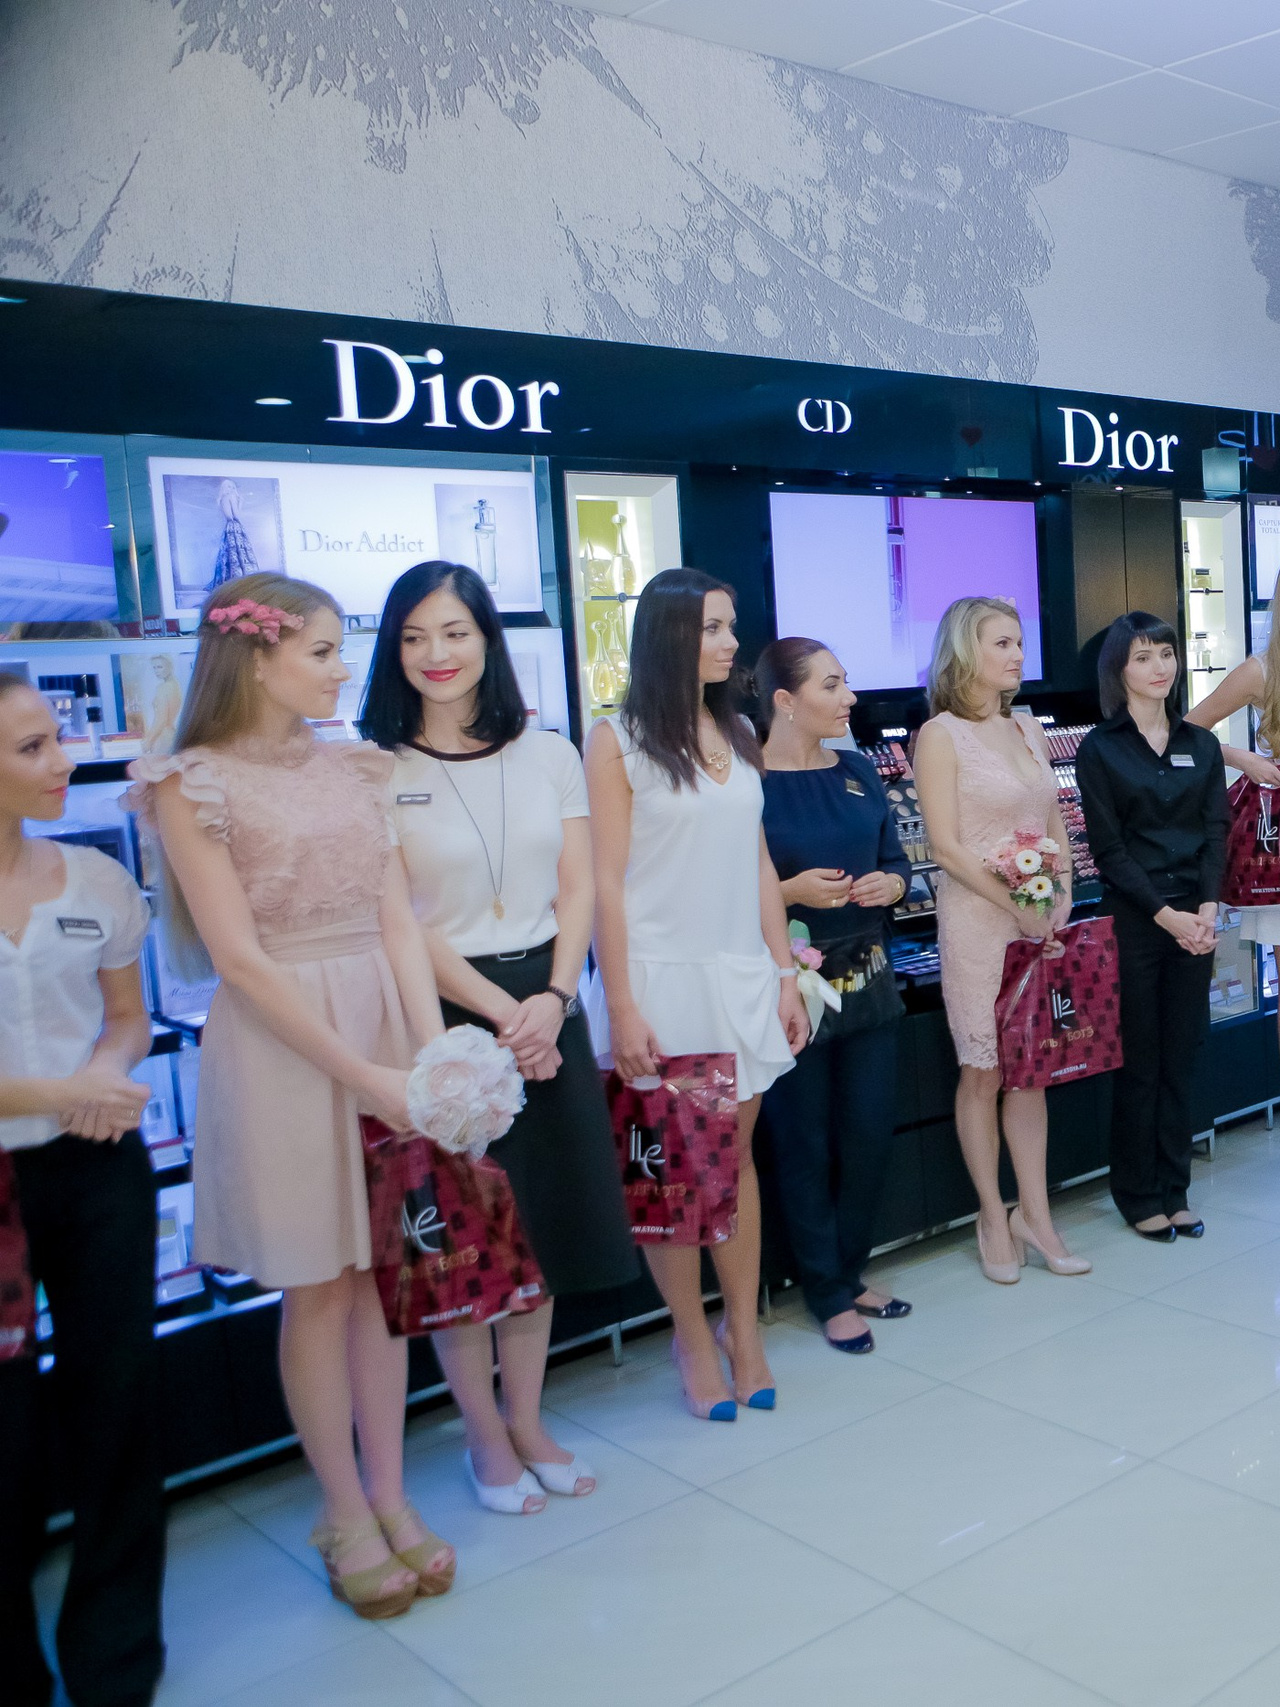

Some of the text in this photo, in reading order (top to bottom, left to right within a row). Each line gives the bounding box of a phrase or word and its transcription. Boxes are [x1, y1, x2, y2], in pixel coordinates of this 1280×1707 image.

[322, 339, 560, 433] Dior
[797, 398, 852, 434] CD
[1057, 407, 1179, 473] Dior
[298, 528, 424, 552] Dior Addict
